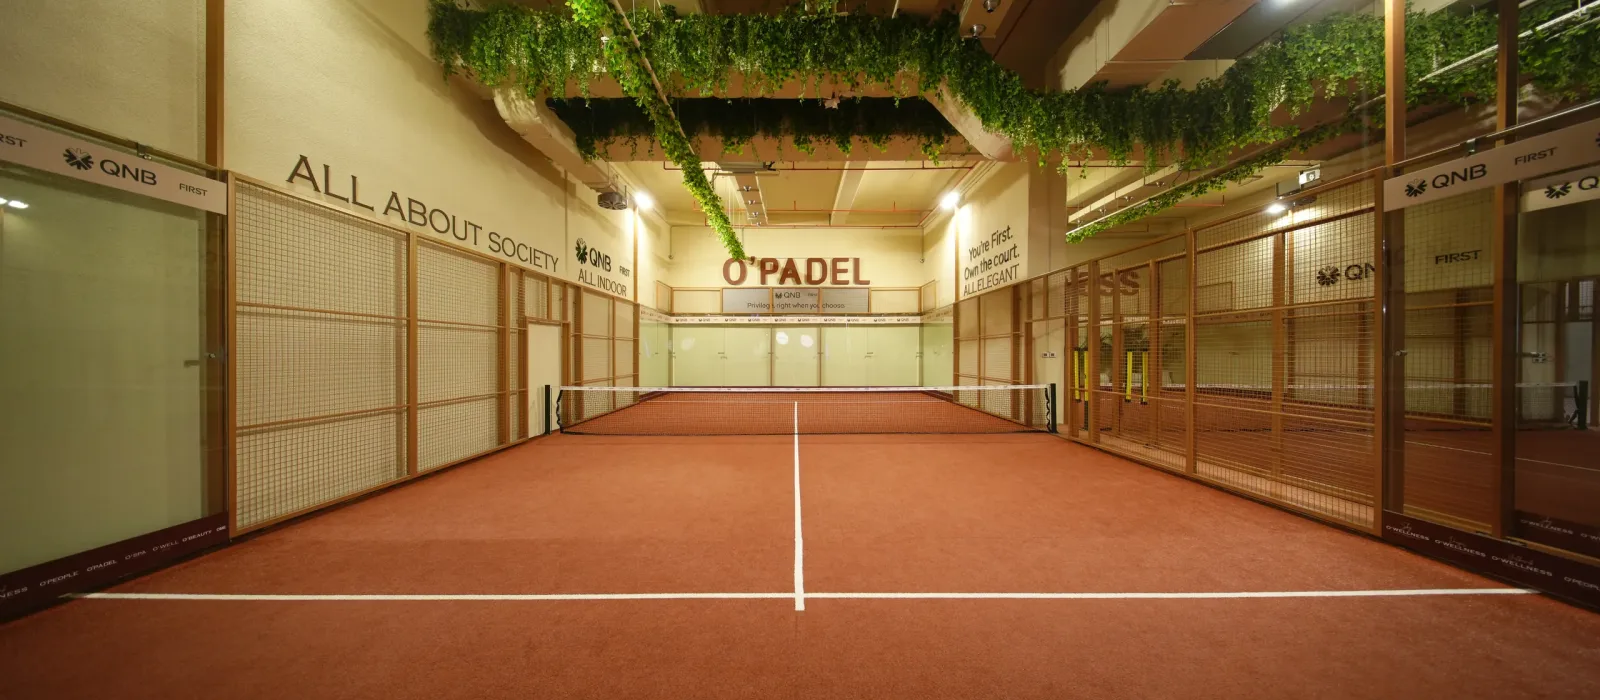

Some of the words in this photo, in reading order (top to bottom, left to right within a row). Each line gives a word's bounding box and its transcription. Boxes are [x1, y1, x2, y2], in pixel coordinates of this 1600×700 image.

[100, 159, 157, 186] QNB
[179, 183, 208, 197] FIRST
[1432, 163, 1487, 189] QNB
[1514, 147, 1558, 165] FIRST
[285, 154, 375, 212] ALL
[382, 190, 483, 246] ABOUT
[488, 231, 560, 273] SOCIETY
[589, 247, 612, 272] QNB
[619, 265, 630, 277] FIRST
[964, 266, 979, 281] Own
[980, 258, 992, 273] the
[993, 243, 1020, 267] court.
[968, 240, 989, 262] You're
[991, 225, 1013, 249] First.
[578, 268, 596, 287] ALL
[597, 274, 627, 297] INDOOR
[722, 255, 870, 286] O'PADEL
[1344, 262, 1376, 281] QN
[1435, 250, 1483, 265] FIRST
[776, 302, 791, 310] right
[39, 570, 79, 587] O'PEOPLE
[86, 559, 117, 572] O'PADEL
[125, 550, 147, 560] O'SPA
[152, 540, 179, 552] O'WELL
[182, 529, 212, 542] O'BEAUTY
[1386, 525, 1430, 541] O'WELLNESS
[1434, 539, 1487, 557] O'WELLNESS
[1491, 555, 1553, 577] O'WELLNESS
